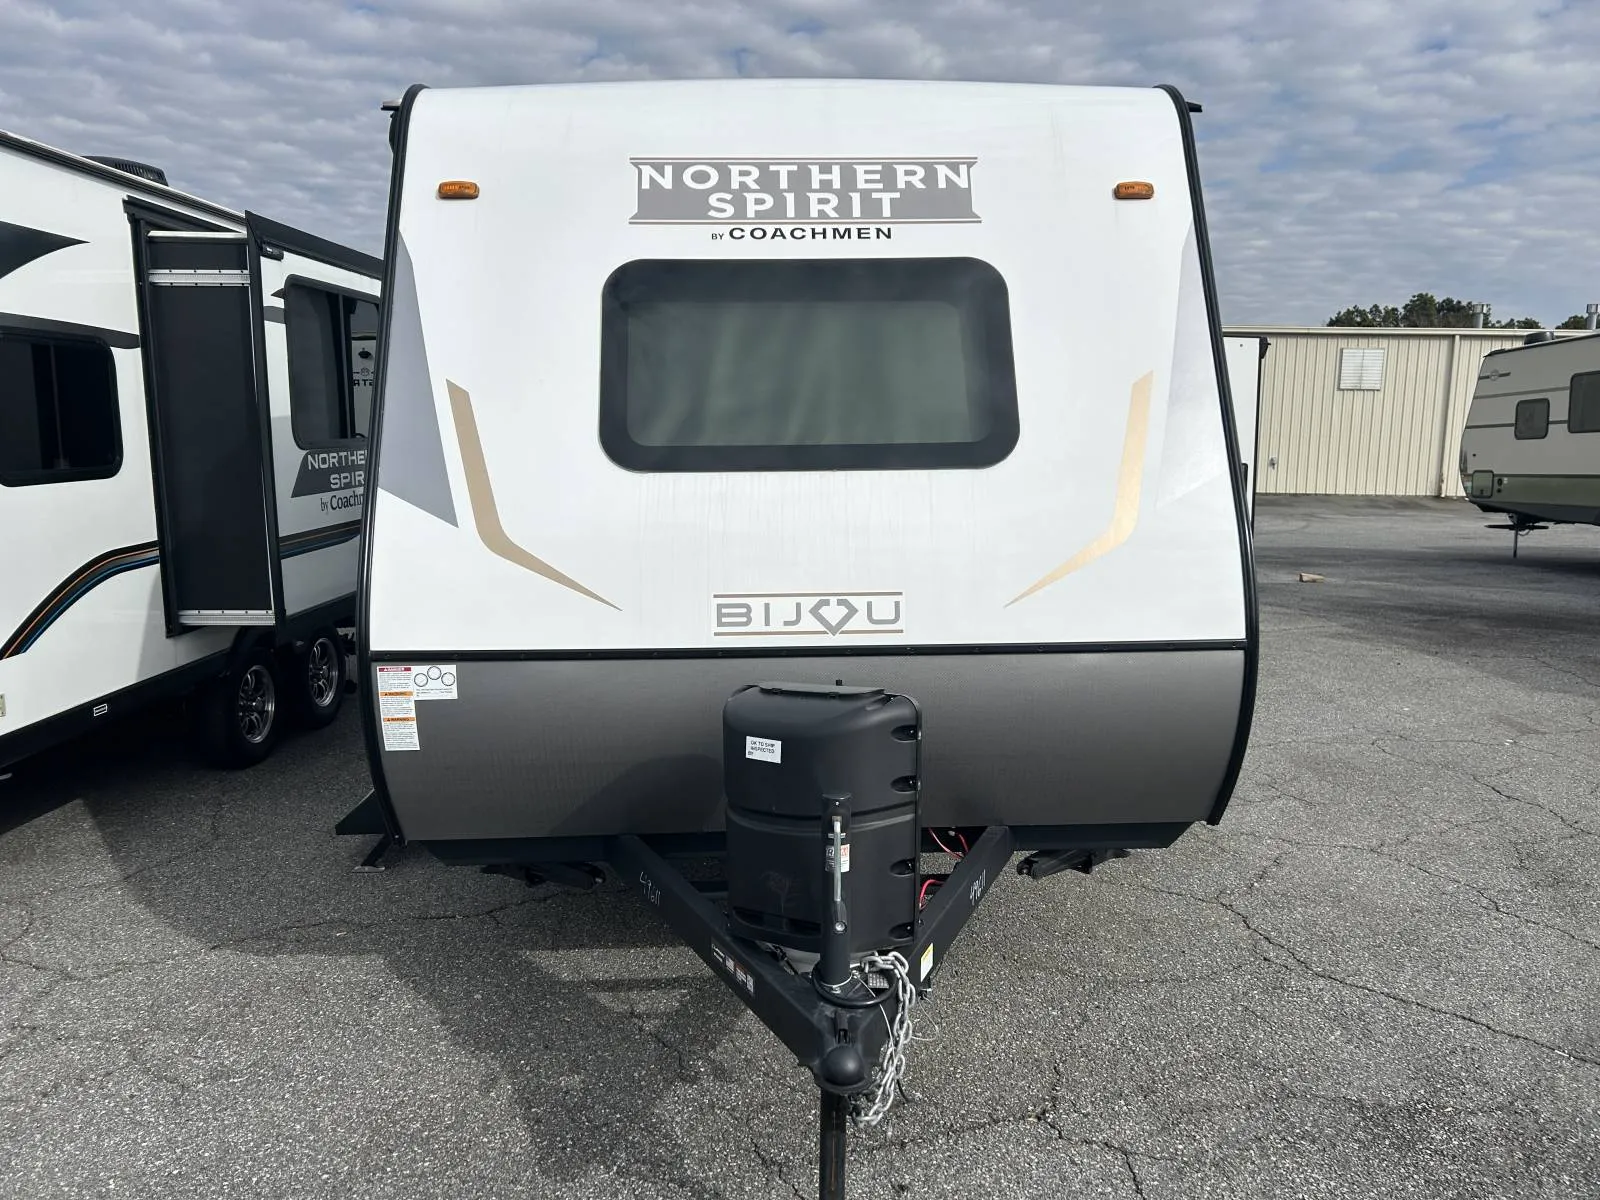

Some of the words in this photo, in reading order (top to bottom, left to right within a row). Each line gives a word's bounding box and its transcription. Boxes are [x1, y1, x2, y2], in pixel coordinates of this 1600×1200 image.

[637, 164, 969, 190] NORTHERN
[707, 191, 901, 218] SPIRIT
[711, 232, 726, 241] BY
[728, 226, 893, 241] COACHMEN
[307, 450, 367, 470] NORTHE
[329, 470, 365, 489] SPIR
[320, 497, 329, 515] by
[330, 490, 364, 511] Coach
